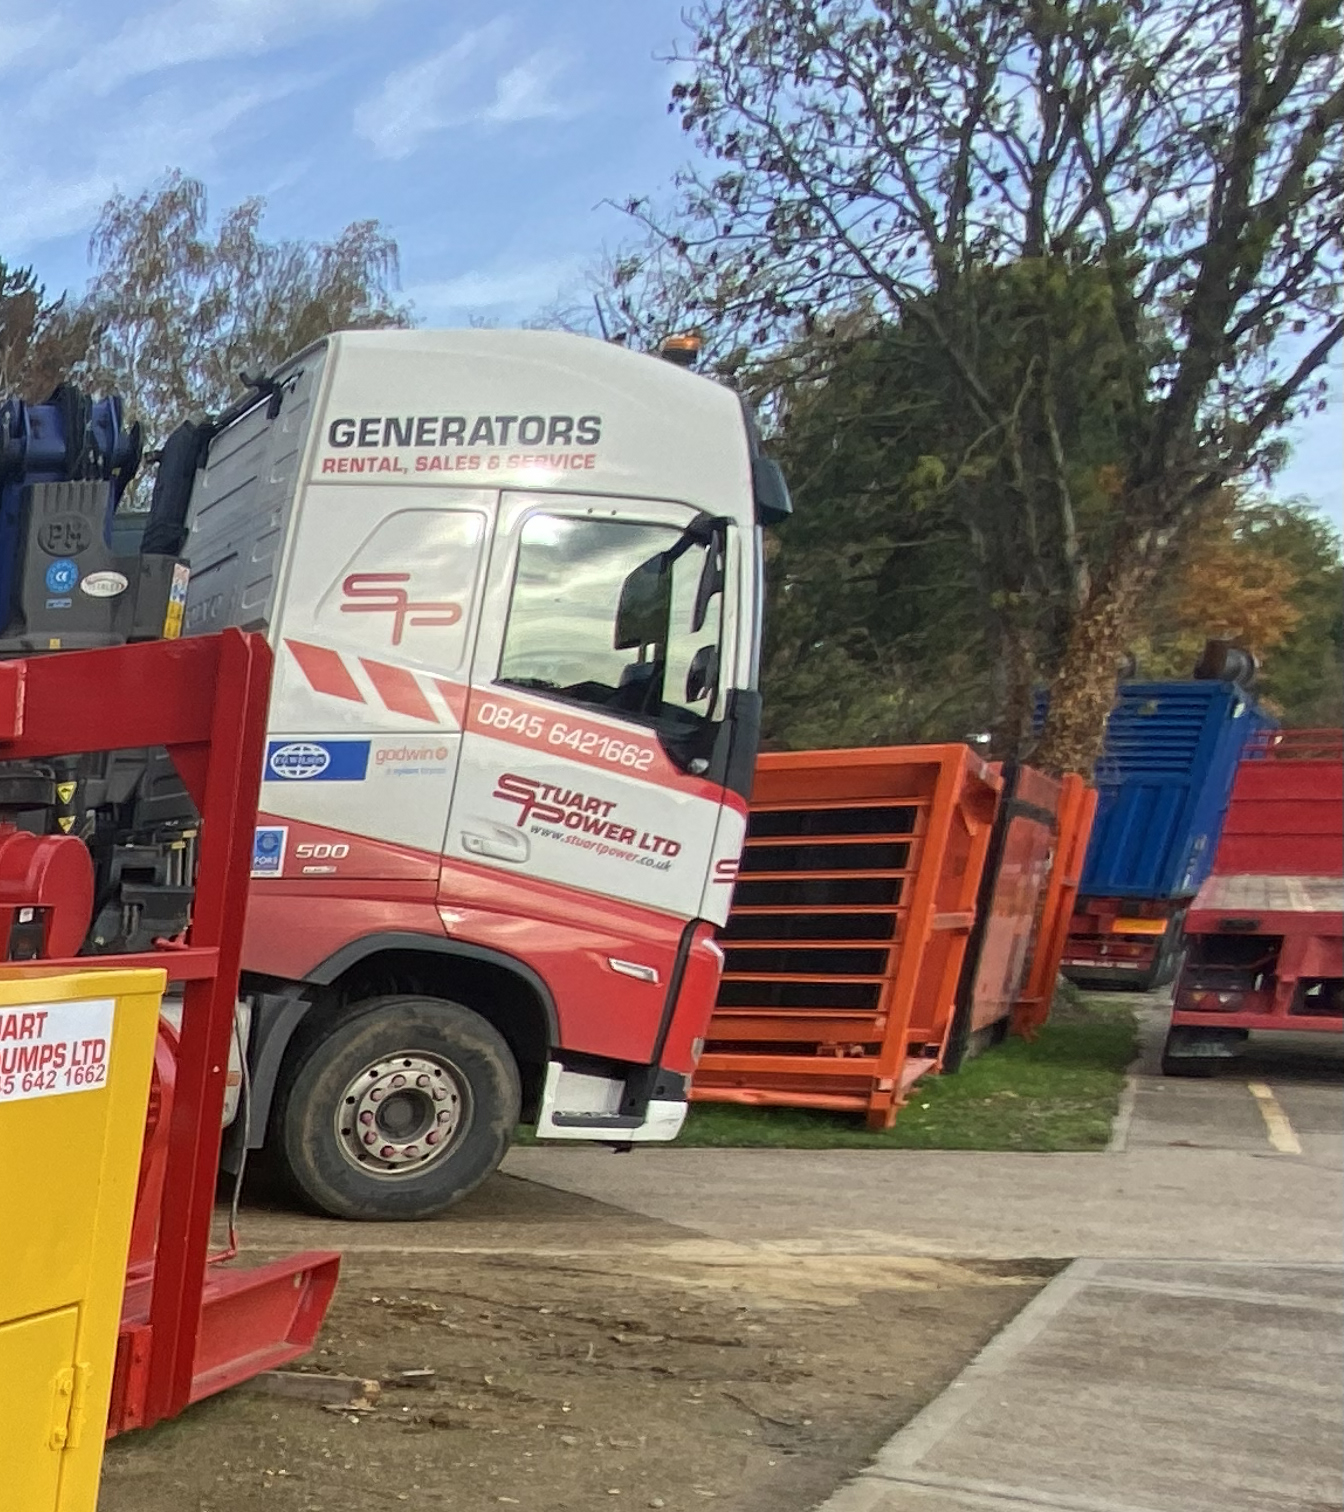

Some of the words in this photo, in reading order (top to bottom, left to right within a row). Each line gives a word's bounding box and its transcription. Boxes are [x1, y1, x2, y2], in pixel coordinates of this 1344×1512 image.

[328, 415, 602, 449] GENERATORS
[322, 456, 409, 475] RENTAL,
[415, 454, 481, 472] SALES
[487, 456, 500, 470] &
[506, 454, 597, 471] SERVICE
[477, 703, 546, 738] 0845
[548, 723, 654, 772] 6421662
[375, 745, 434, 765] godwin
[493, 773, 618, 818] STUART
[516, 800, 637, 845] POWER
[638, 832, 682, 858] LTD
[295, 844, 351, 859] 500
[530, 824, 672, 872] www.stuartpower.co.uk
[71, 1038, 106, 1067] LTD
[22, 1070, 57, 1093] 642
[64, 1064, 106, 1086] 1662
